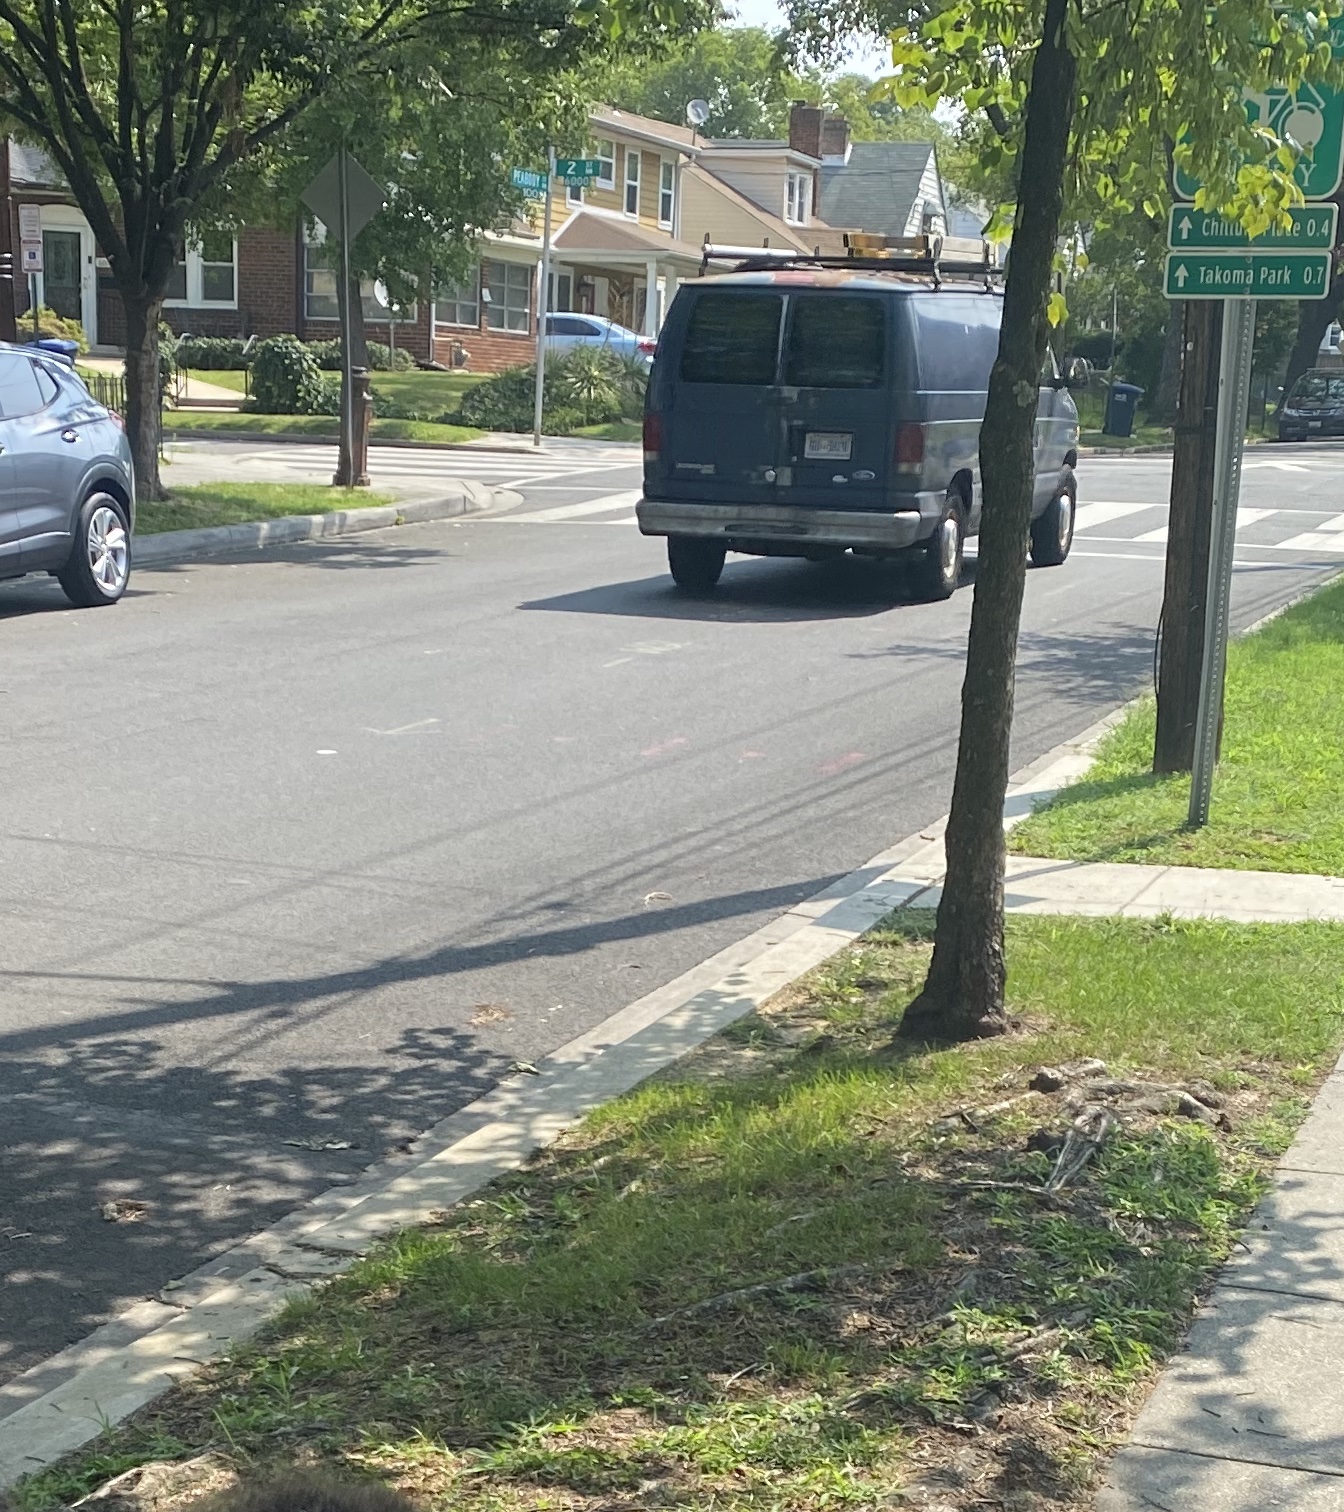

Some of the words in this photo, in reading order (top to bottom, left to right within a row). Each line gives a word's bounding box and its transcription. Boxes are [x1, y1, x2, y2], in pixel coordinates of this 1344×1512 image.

[567, 161, 576, 175] 2
[564, 177, 589, 187] 6000
[1202, 217, 1248, 236] Chillu
[1306, 219, 1329, 236] 0.4
[1199, 265, 1254, 284] Takoma
[1259, 265, 1291, 285] Park
[1303, 266, 1324, 284] 0.7
